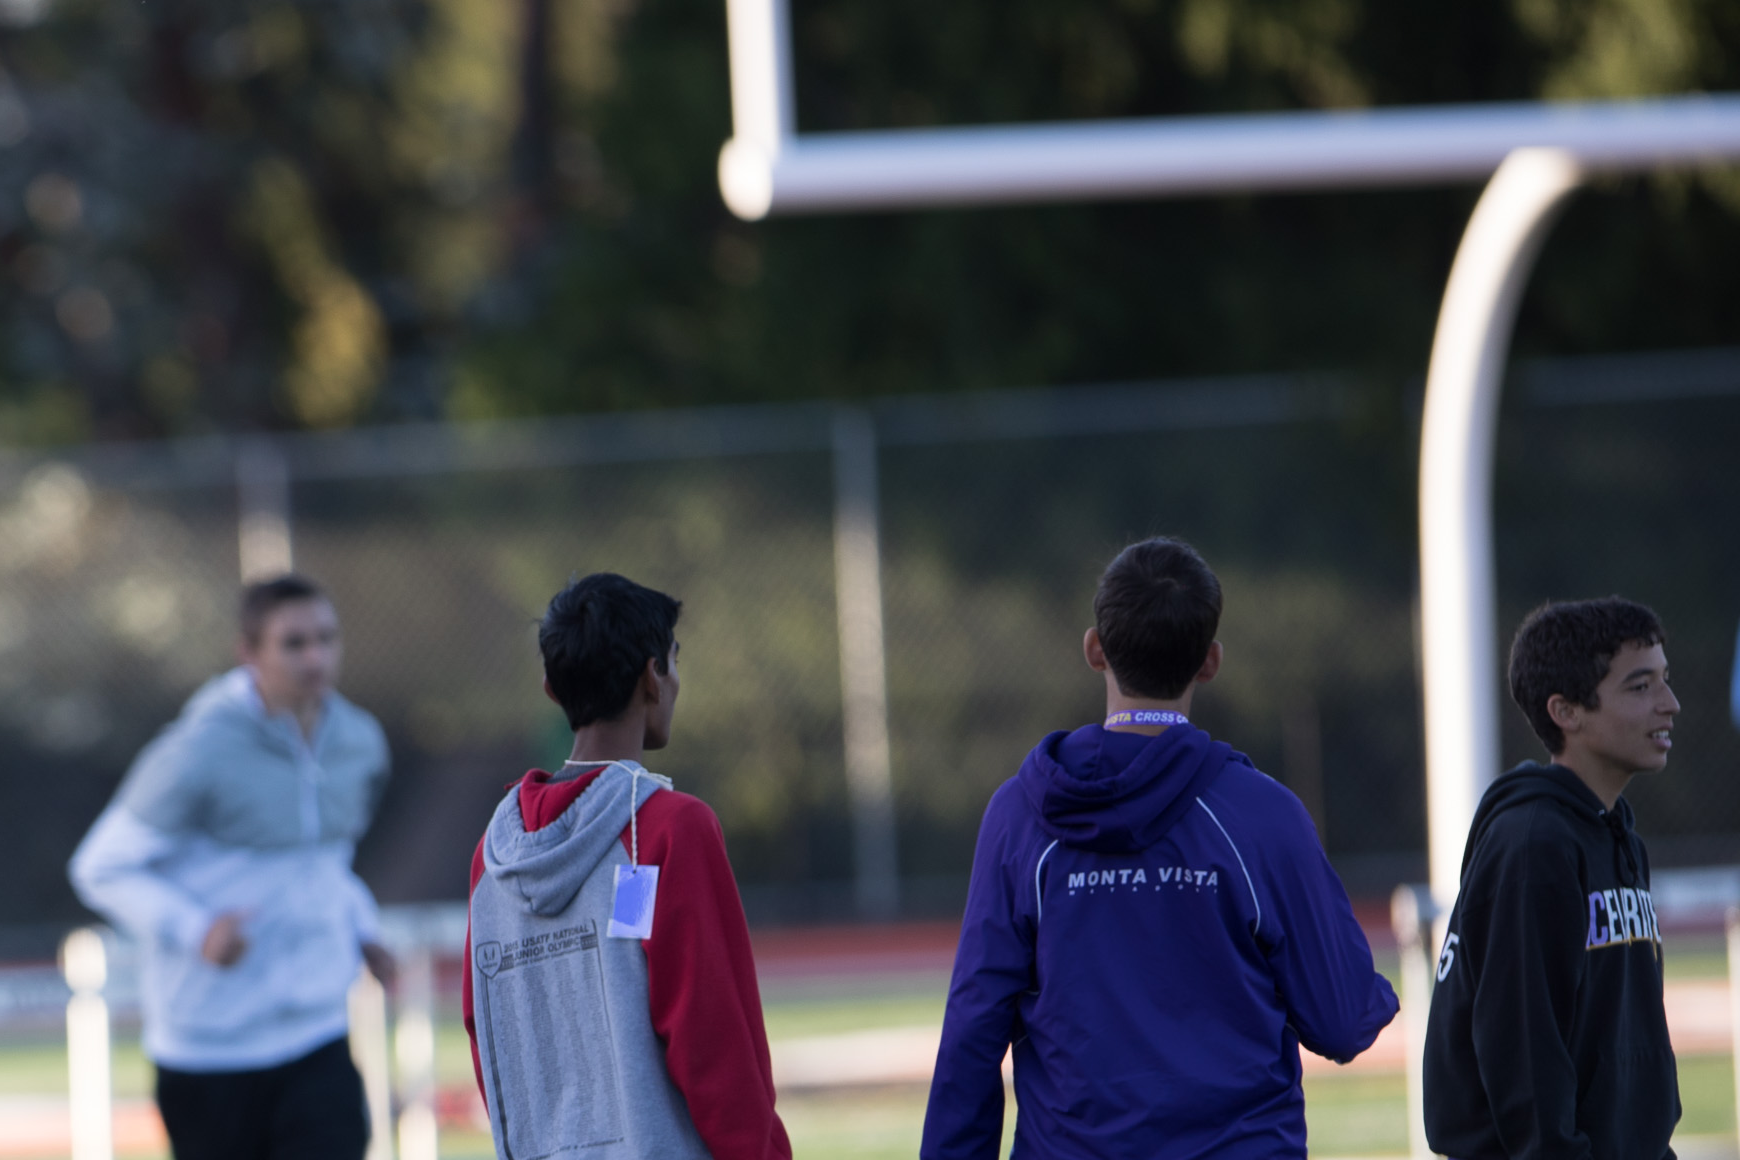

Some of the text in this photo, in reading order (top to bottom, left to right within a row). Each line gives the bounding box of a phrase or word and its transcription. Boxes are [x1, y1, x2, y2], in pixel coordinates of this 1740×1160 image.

[1135, 711, 1174, 722] CROSS
[1068, 867, 1218, 888] MONTA VISTA
